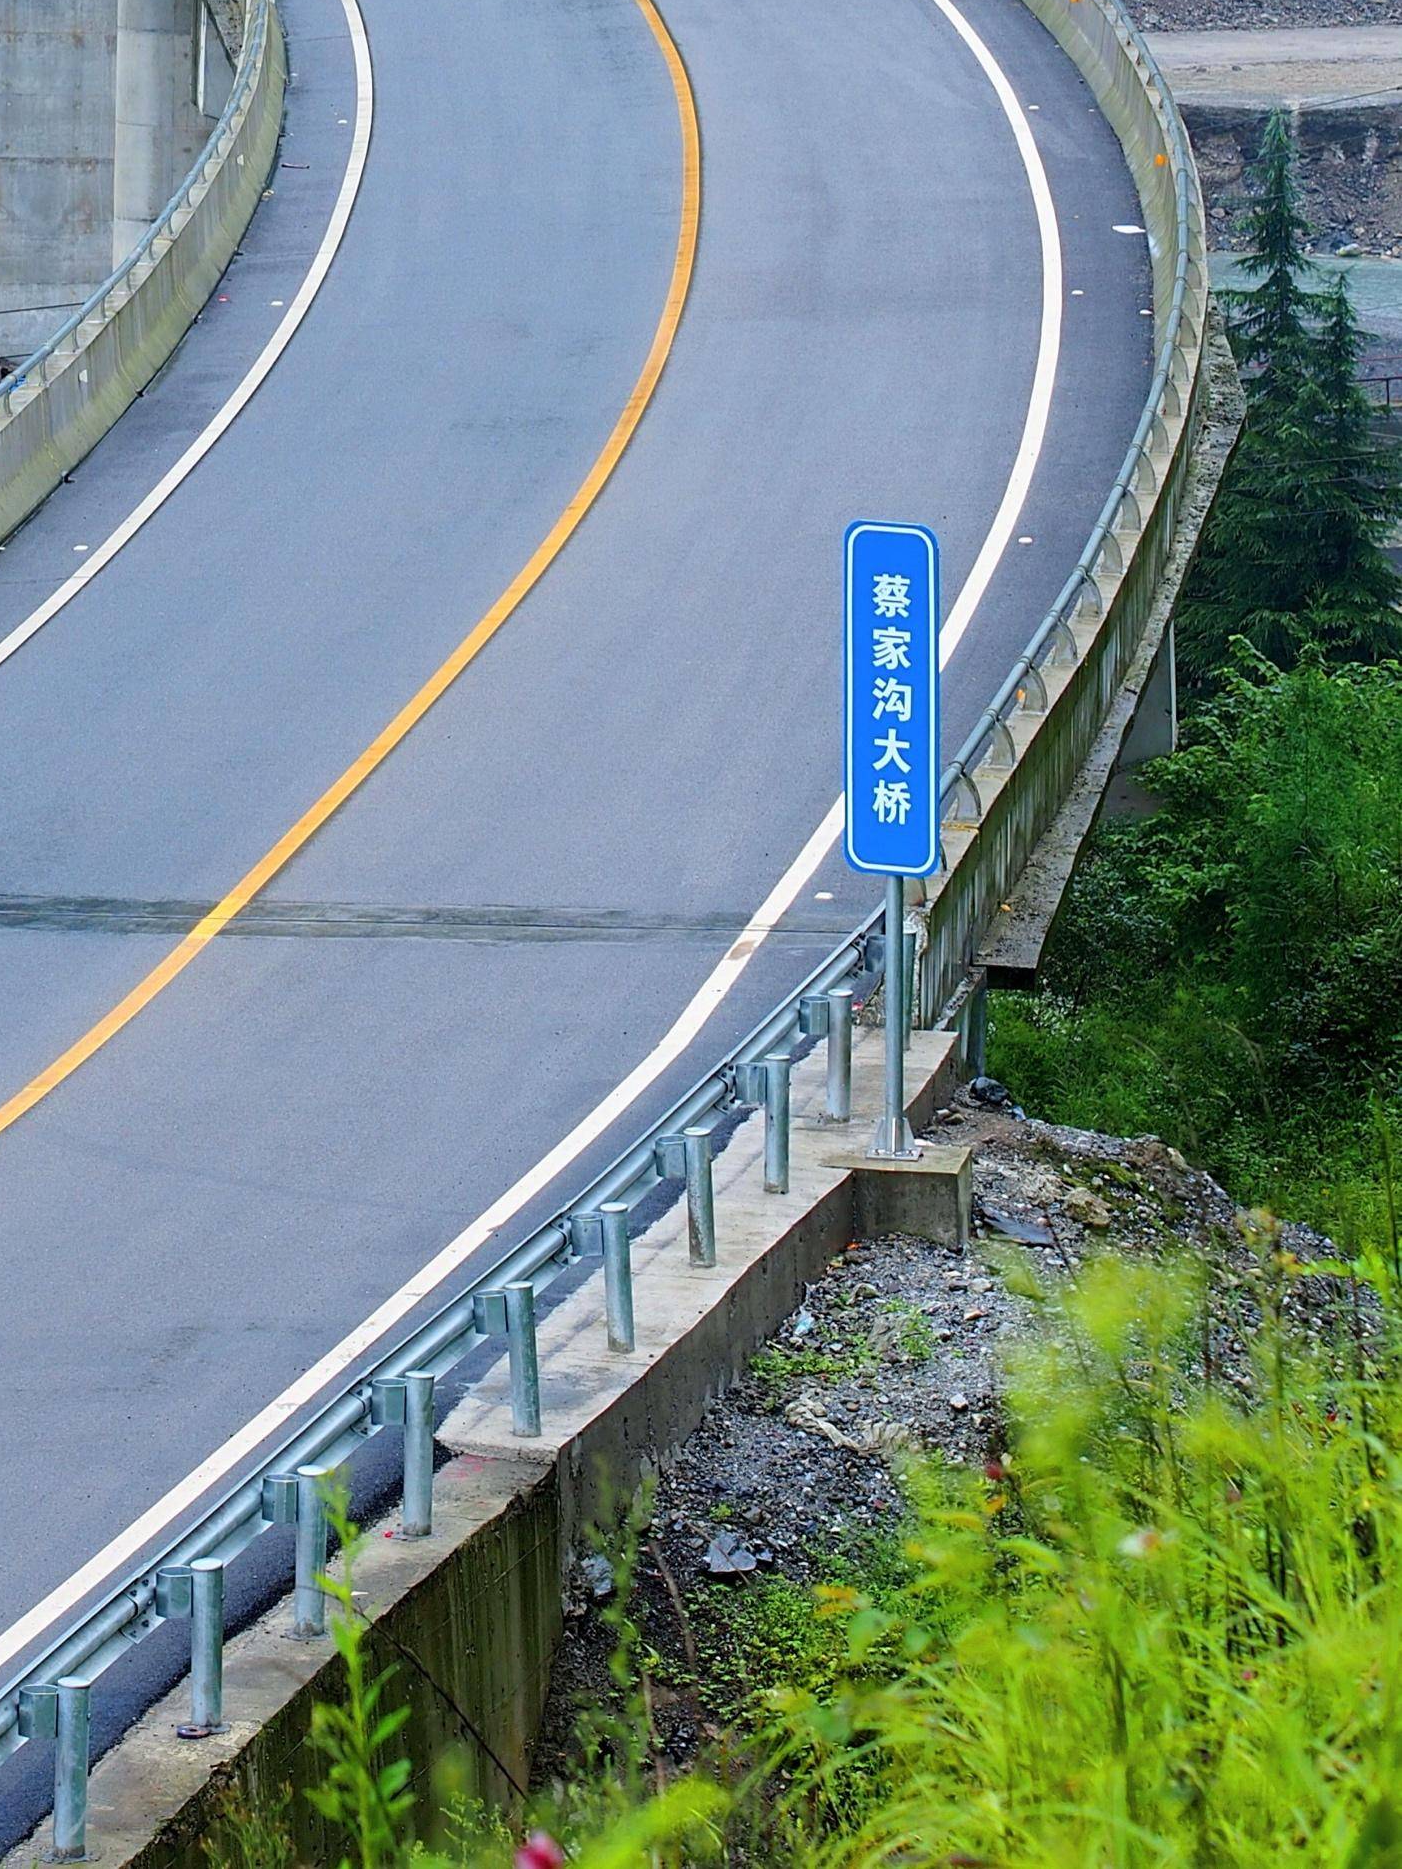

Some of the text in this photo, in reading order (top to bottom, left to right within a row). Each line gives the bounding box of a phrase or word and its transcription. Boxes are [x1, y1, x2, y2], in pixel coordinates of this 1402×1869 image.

[872, 573, 912, 825] 蔡家沟大桥
